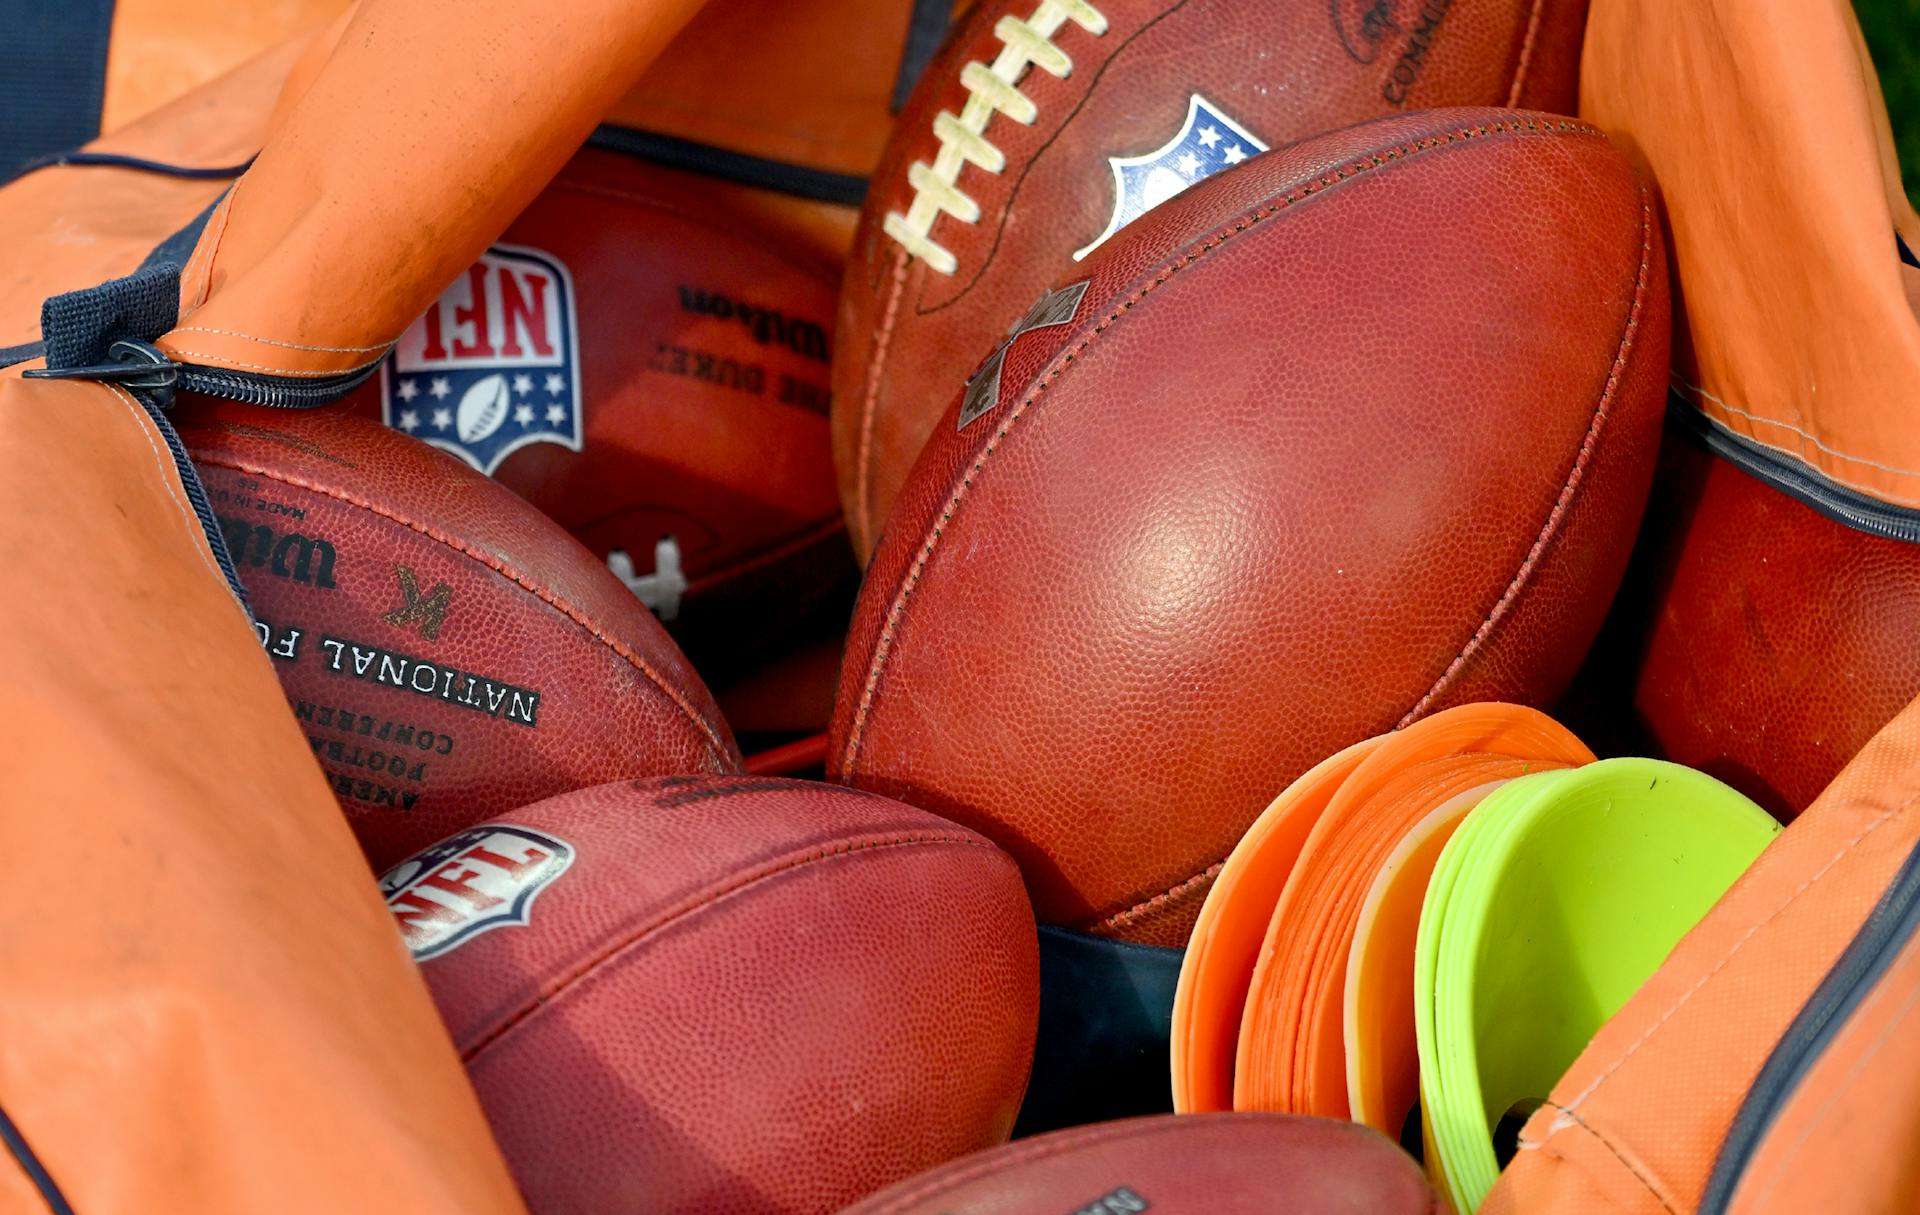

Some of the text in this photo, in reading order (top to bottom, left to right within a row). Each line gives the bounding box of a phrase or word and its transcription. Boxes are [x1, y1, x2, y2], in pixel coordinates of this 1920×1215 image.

[235, 495, 250, 508] IN
[257, 500, 306, 521] MADE
[383, 564, 454, 641] K
[324, 639, 536, 722] NATIONAL
[391, 845, 550, 943] NFL
